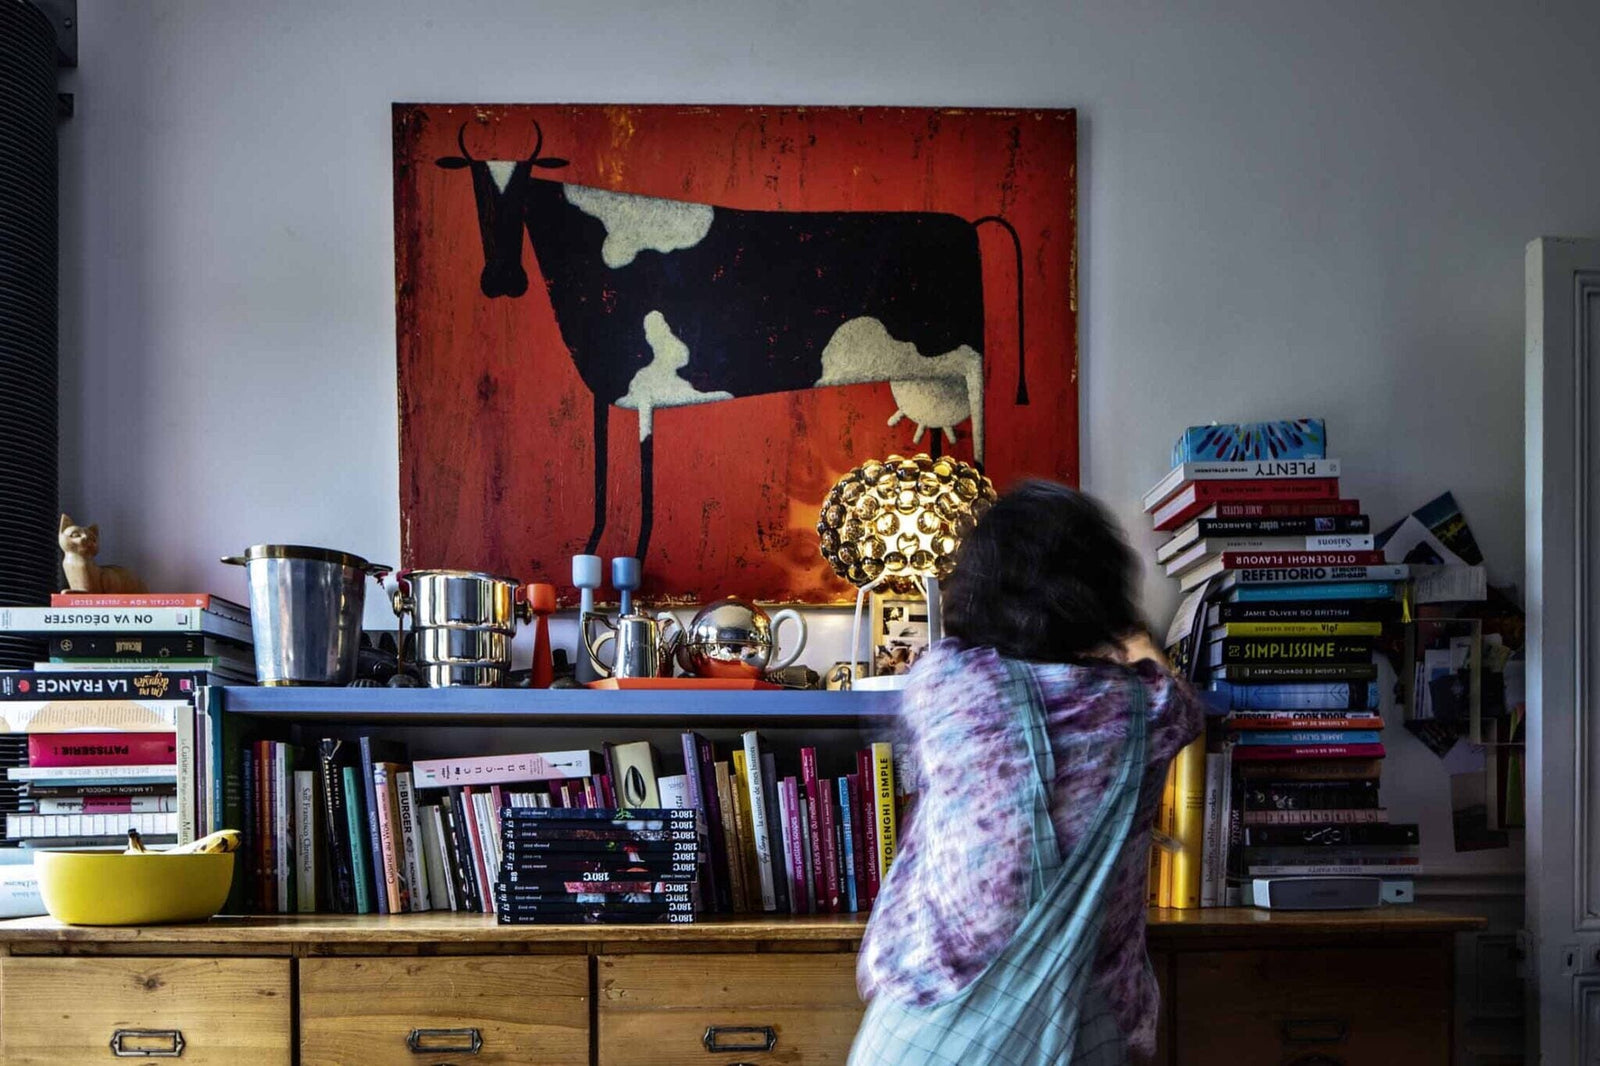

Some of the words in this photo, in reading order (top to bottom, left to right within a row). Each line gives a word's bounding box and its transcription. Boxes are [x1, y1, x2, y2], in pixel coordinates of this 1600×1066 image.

[1255, 462, 1316, 476] PLENTY
[1317, 537, 1352, 547] Saisons
[1235, 555, 1283, 565] FLAVOUR
[1287, 554, 1356, 564] OTTOLENGHI
[1242, 568, 1326, 581] REFETTORIO
[44, 613, 109, 626] DÉGUSTER
[113, 614, 130, 624] VA
[134, 614, 153, 624] ON
[1243, 608, 1266, 617] JAMIE
[1268, 608, 1298, 617] OLIVER
[1314, 608, 1350, 617] BRITISH
[1243, 642, 1335, 659] SIMPLISSIME
[37, 679, 103, 692] FRANCE
[107, 679, 128, 692] LA
[181, 746, 191, 776] Cuisine
[880, 757, 889, 798] SIMPLE
[753, 786, 760, 795] de
[400, 791, 412, 833] BURGER
[754, 797, 763, 819] cuisine
[302, 802, 310, 836] Francisco
[790, 816, 800, 840] soupes
[882, 804, 895, 874] TTOLENGHI
[302, 838, 311, 872] Chronicle
[792, 841, 802, 865] petites
[384, 853, 395, 884] Cuisiner
